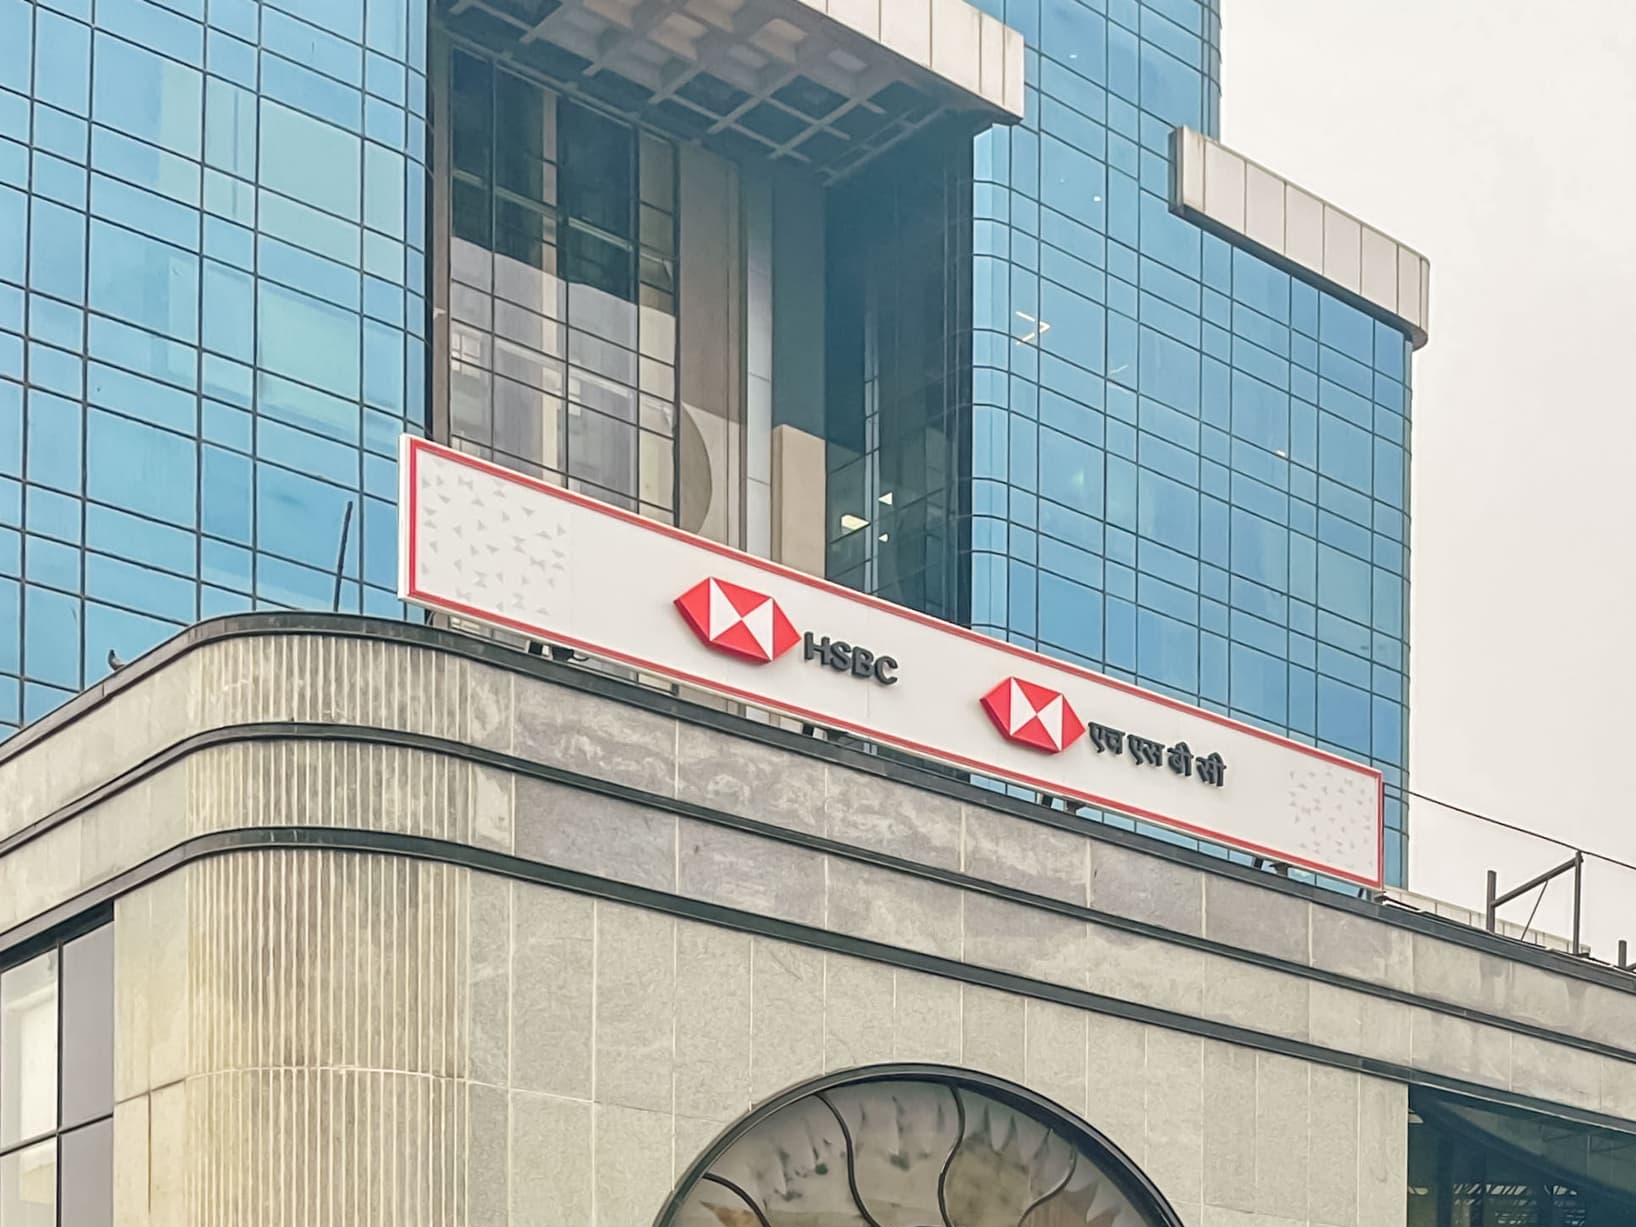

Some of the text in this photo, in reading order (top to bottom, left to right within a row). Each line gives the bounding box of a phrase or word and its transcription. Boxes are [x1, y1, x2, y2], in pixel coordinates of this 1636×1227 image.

[804, 631, 898, 686] HSBC
[1088, 721, 1227, 788] एच एस बी सी
